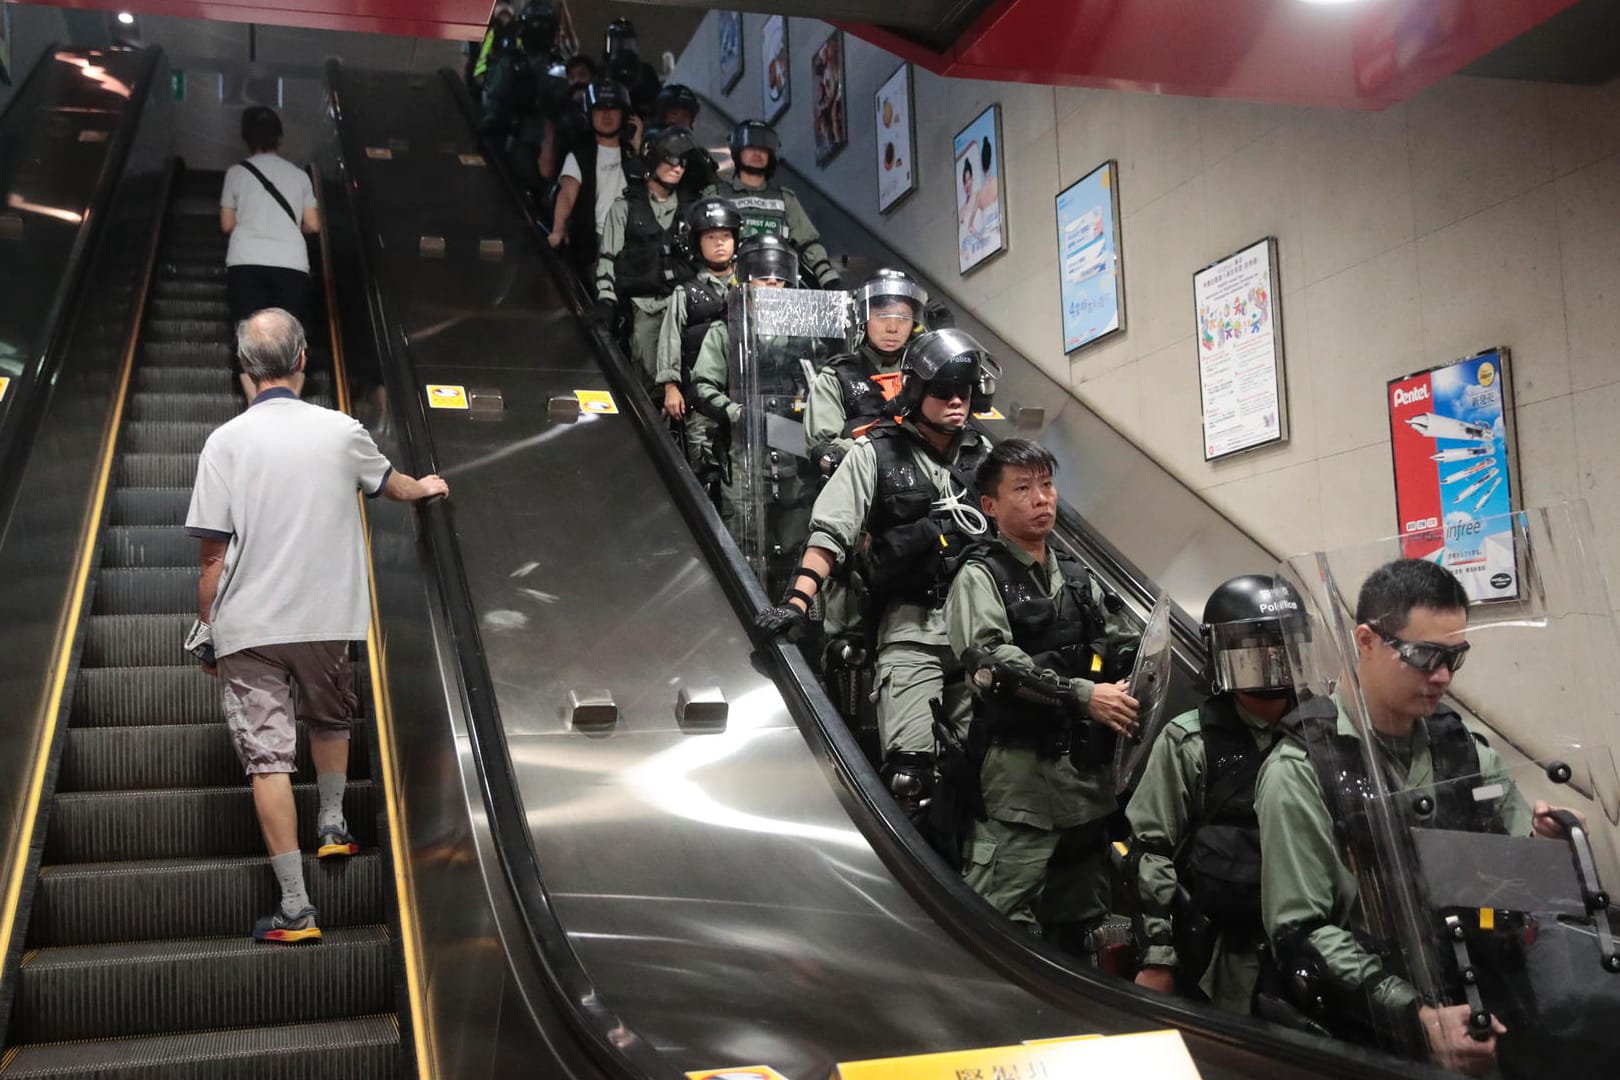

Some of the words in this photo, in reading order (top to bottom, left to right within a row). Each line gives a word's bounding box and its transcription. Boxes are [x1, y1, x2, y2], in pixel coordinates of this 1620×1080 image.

[746, 219, 764, 227] FIRST
[950, 355, 972, 363] Police
[1393, 384, 1430, 407] Pentel
[1446, 520, 1481, 541] infree
